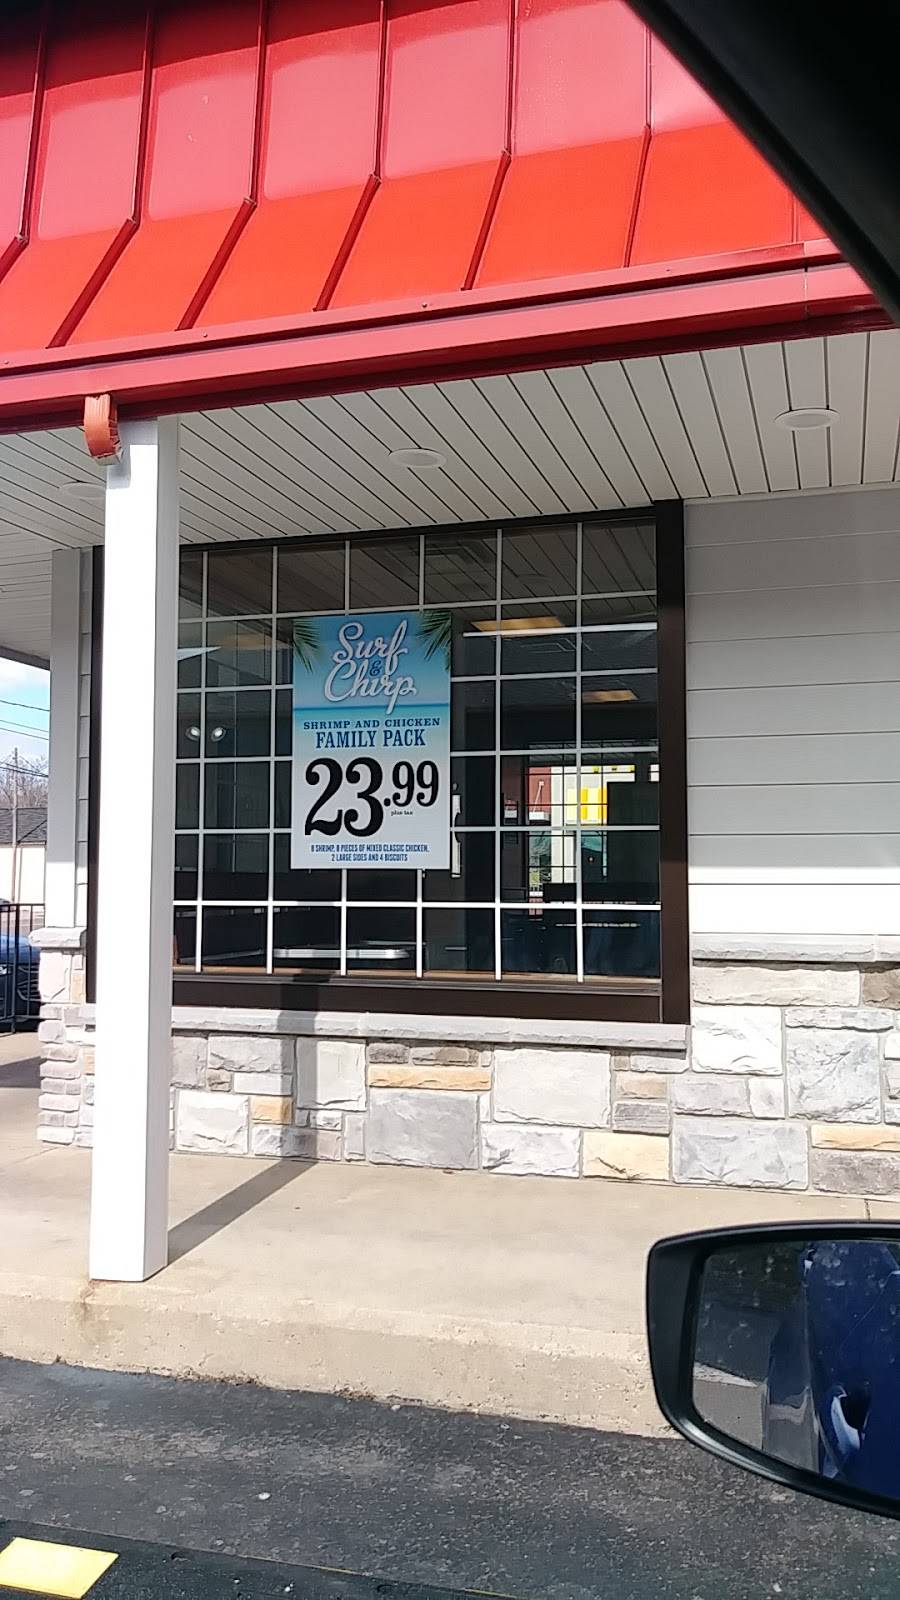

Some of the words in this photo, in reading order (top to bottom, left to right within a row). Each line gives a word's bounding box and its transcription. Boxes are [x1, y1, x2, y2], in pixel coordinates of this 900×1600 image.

[332, 619, 408, 675] Surf
[369, 660, 382, 677] &
[324, 659, 417, 715] Chirp
[303, 720, 351, 730] SHRIMP
[354, 719, 380, 729] AND
[384, 717, 441, 728] CHICKEN
[315, 730, 377, 749] FAMILY
[383, 729, 426, 747] PACK
[304, 756, 439, 837] 23.99
[336, 853, 352, 861] LARGE
[352, 853, 367, 861] SIDES
[367, 853, 379, 861] AND
[384, 853, 408, 861] BISCUITS
[340, 844, 358, 852] PIECES
[358, 844, 366, 852] OF
[366, 844, 382, 852] MIXED
[383, 844, 404, 852] CLASSIC
